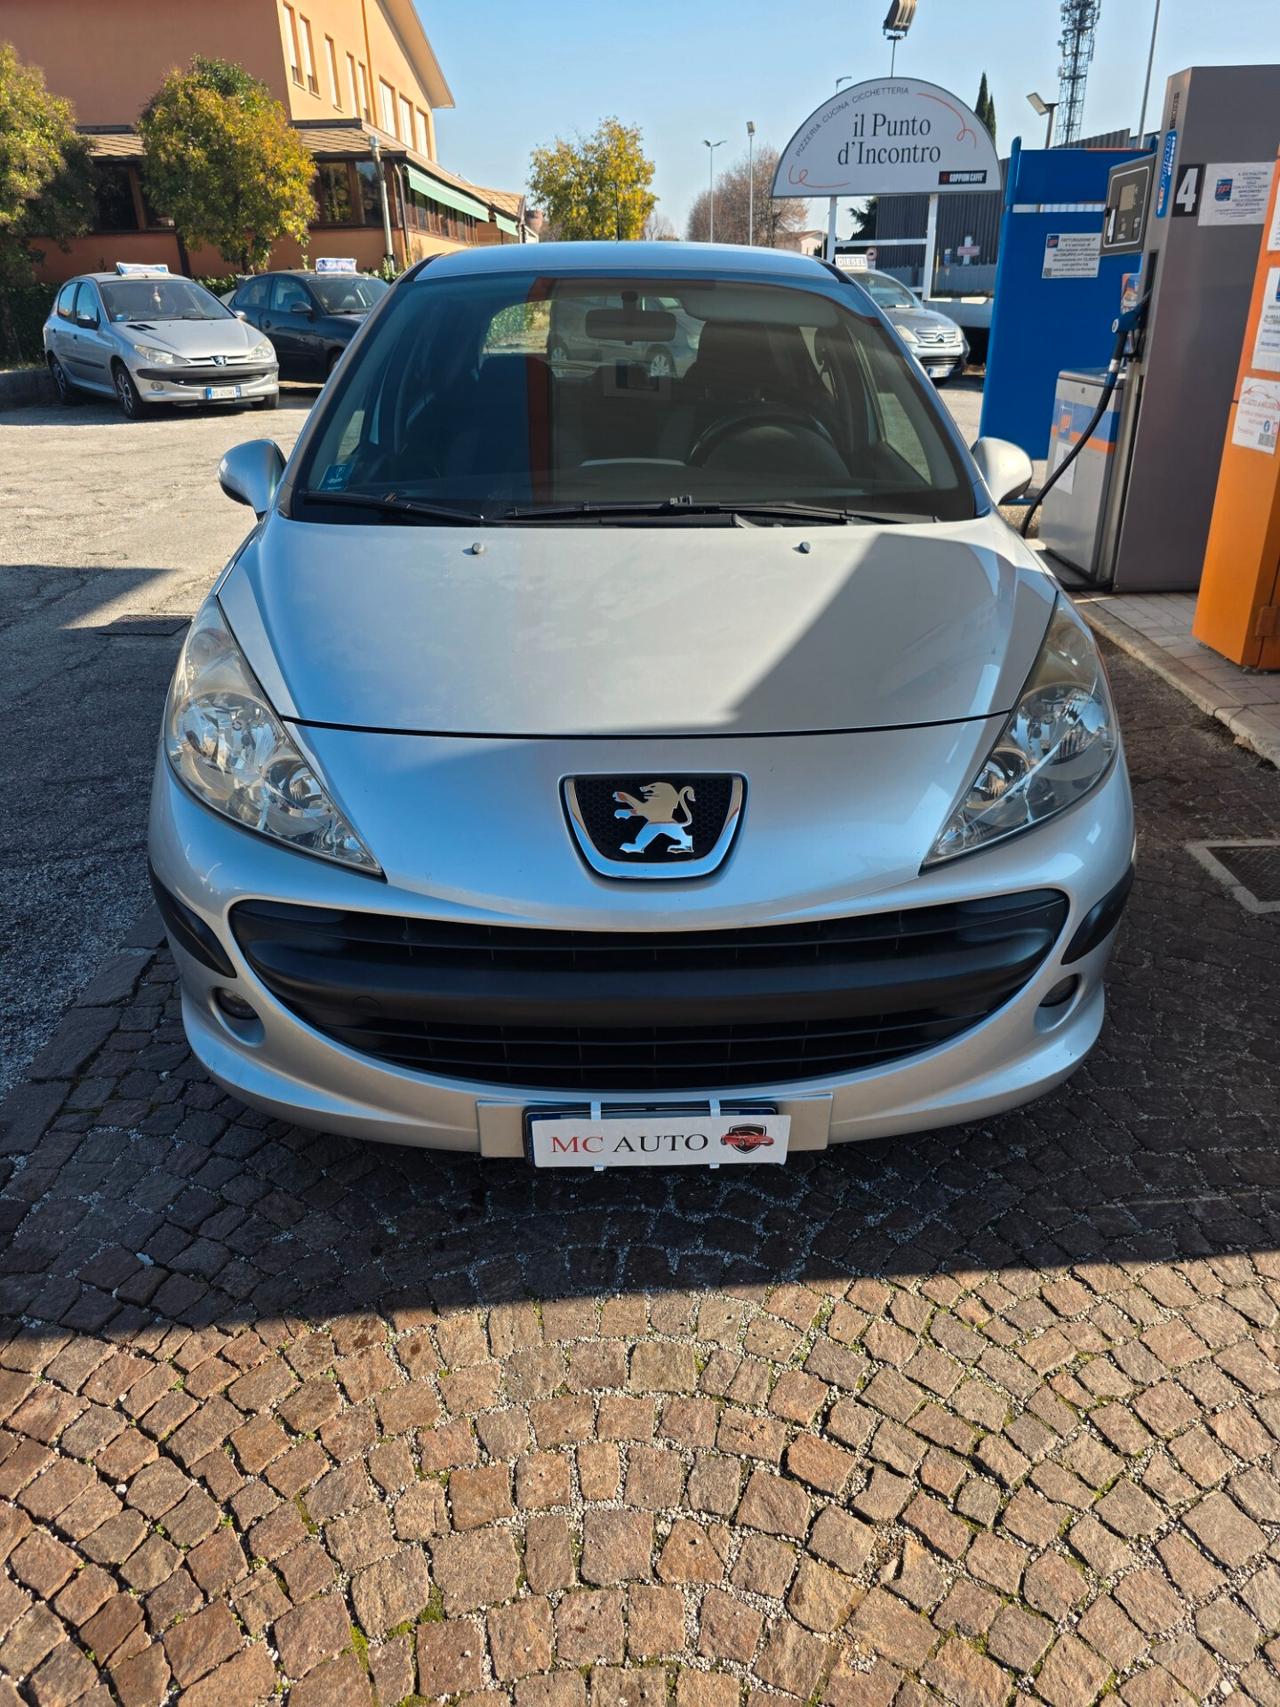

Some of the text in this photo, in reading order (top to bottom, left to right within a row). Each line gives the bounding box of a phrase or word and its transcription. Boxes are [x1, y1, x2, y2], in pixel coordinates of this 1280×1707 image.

[795, 87, 909, 157] PIZZERIA CUCINA CICCHETTERIA
[852, 113, 931, 138] il Punto
[837, 141, 941, 166] d'Incontro
[1176, 168, 1198, 213] 4
[551, 1134, 709, 1153] MC AUTO
